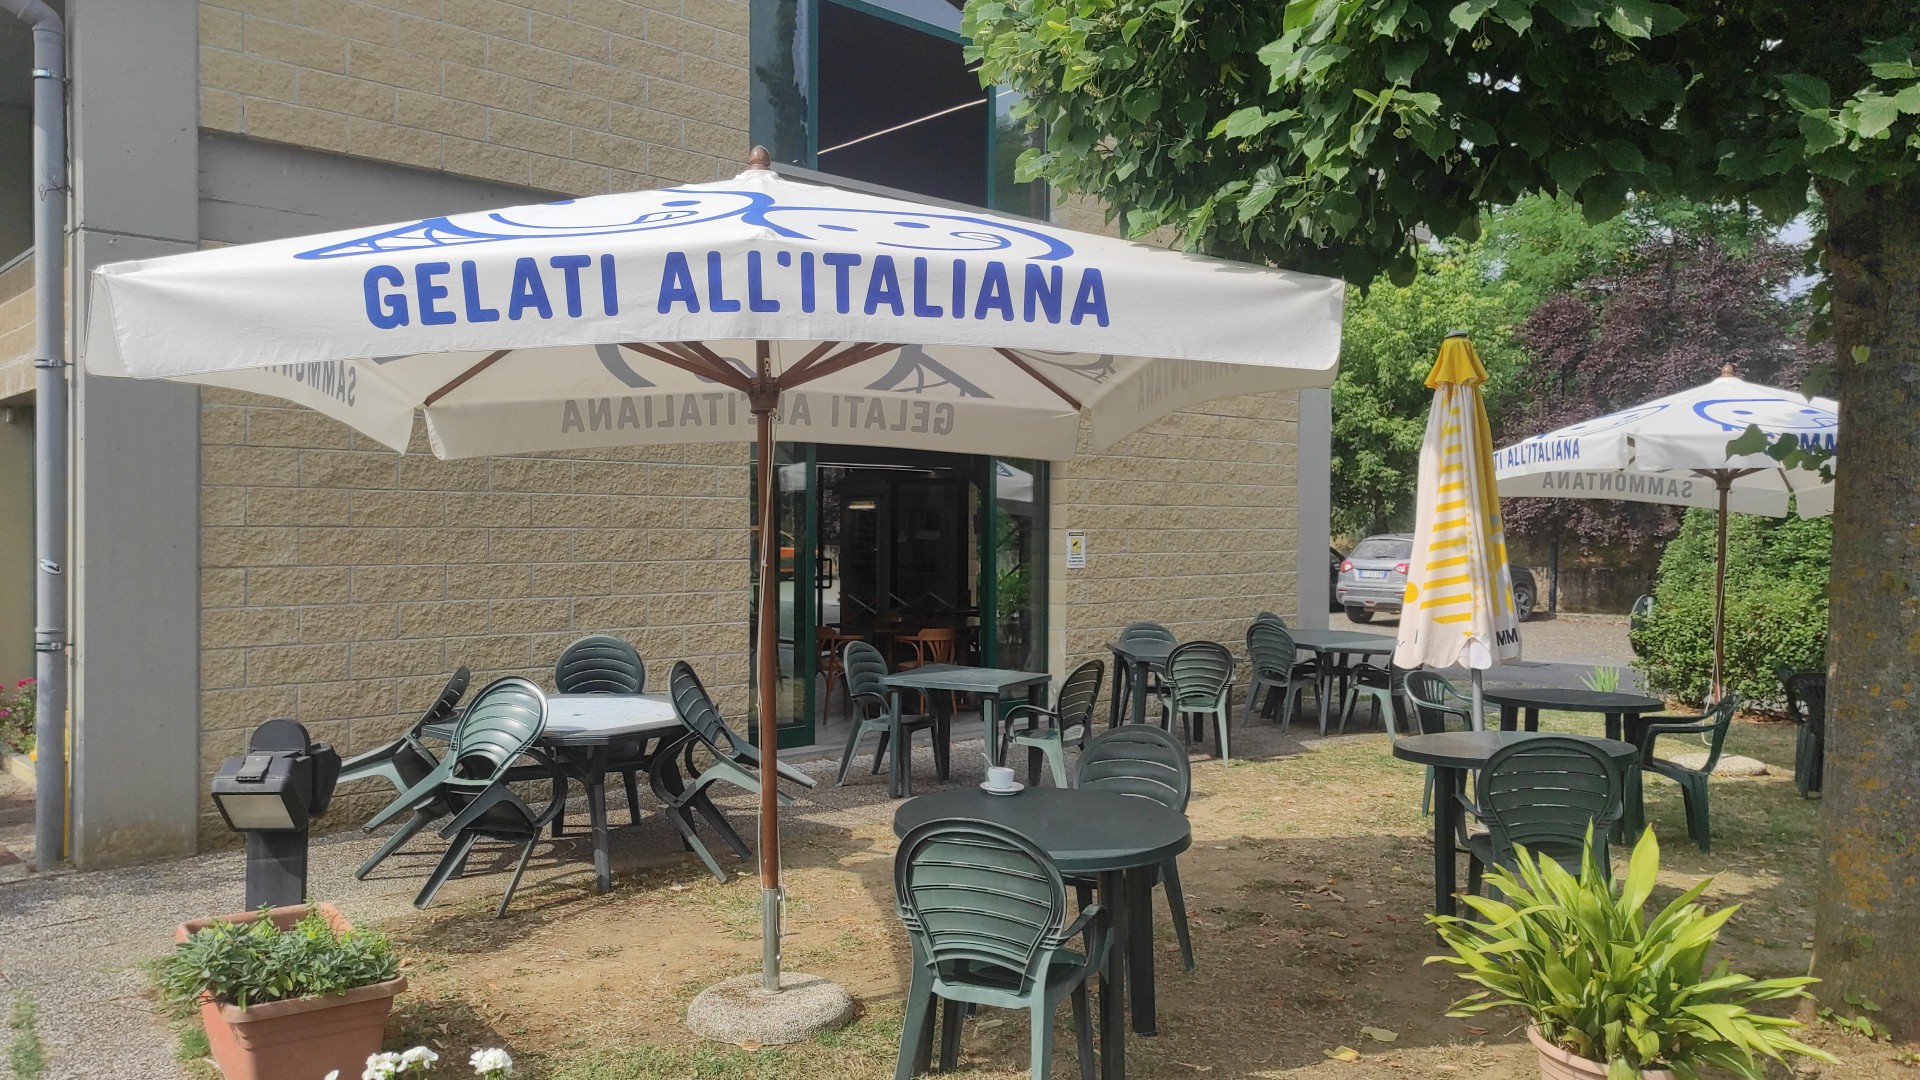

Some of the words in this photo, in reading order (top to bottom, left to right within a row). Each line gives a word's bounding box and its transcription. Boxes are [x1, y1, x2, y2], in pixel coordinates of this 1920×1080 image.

[363, 253, 619, 330] GELATI
[657, 250, 1110, 328] ALL'ITALIANA
[1507, 438, 1580, 468] ALL'ITALIANA
